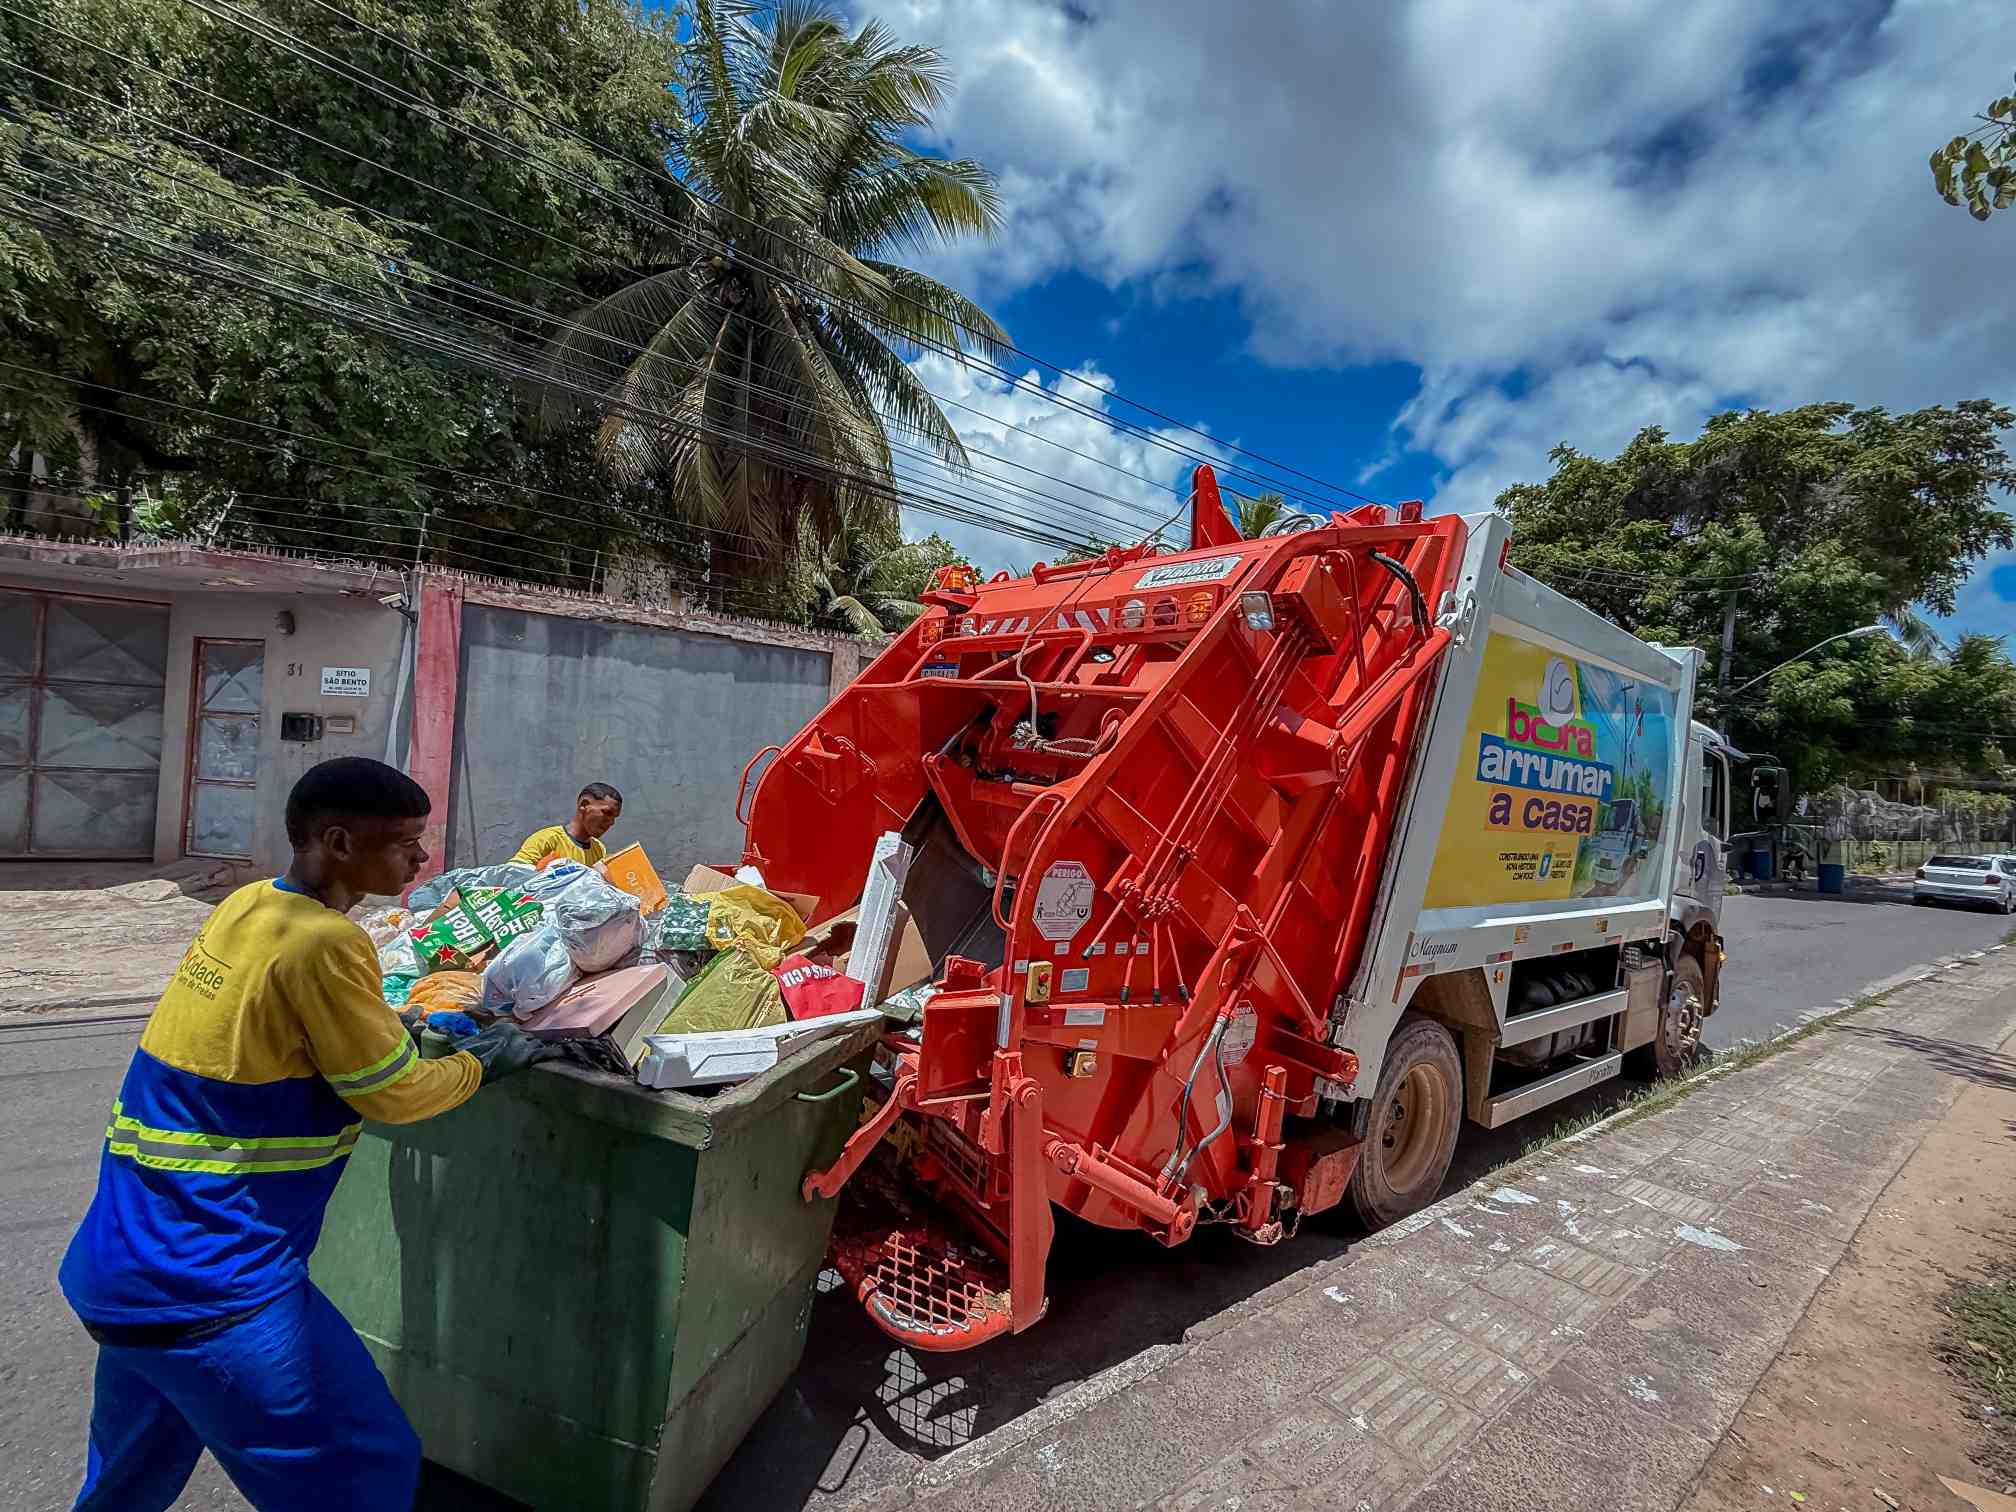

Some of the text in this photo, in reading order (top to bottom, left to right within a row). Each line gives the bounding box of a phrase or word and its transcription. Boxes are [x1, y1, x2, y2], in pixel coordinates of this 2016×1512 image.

[287, 663, 303, 677] 31
[341, 678, 368, 686] BENTO
[1480, 744, 1612, 796] arrumar
[1489, 792, 1593, 833] a casa
[1052, 867, 1083, 878] PERIGO
